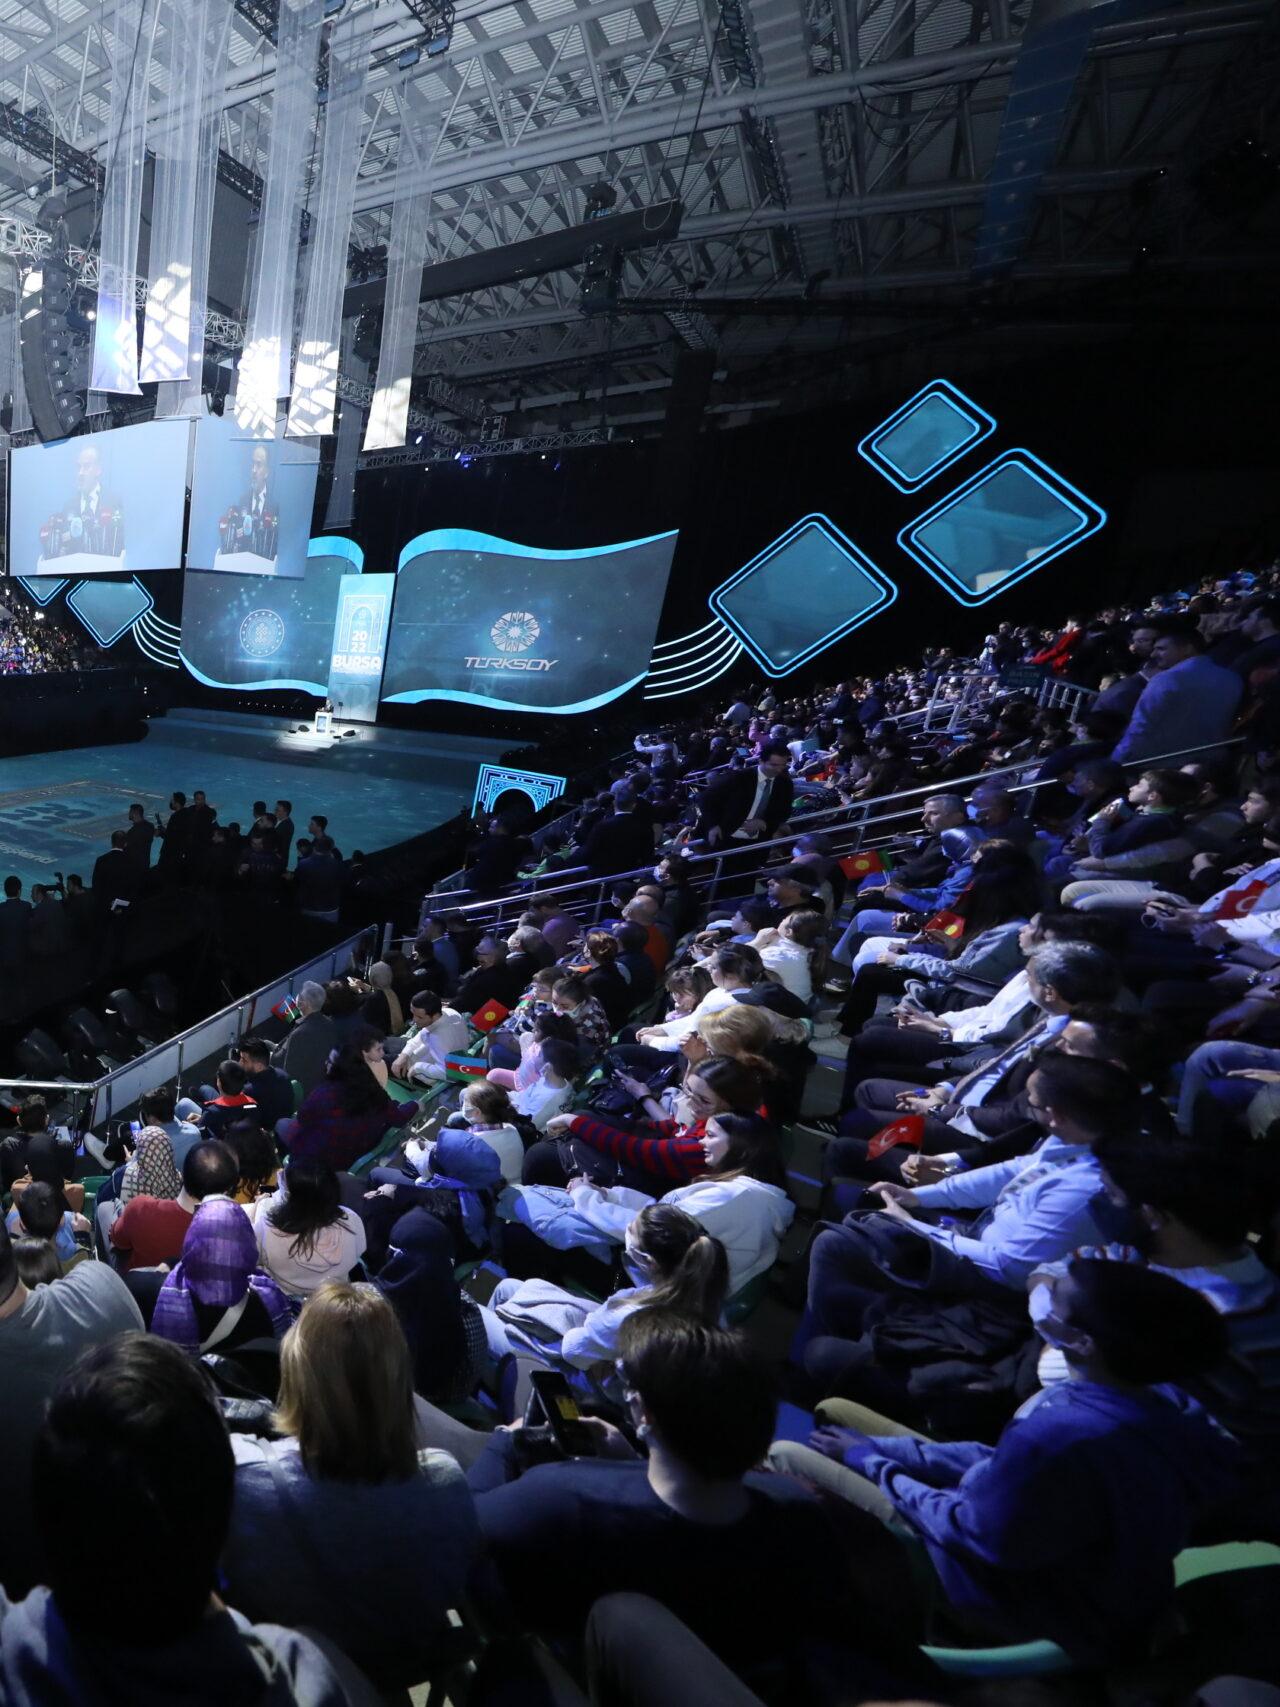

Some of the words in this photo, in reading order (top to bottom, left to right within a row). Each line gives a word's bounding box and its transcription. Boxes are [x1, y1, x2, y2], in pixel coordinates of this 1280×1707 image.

[352, 630, 368, 641] 20
[350, 641, 367, 653] 22
[332, 654, 382, 670] BURSA
